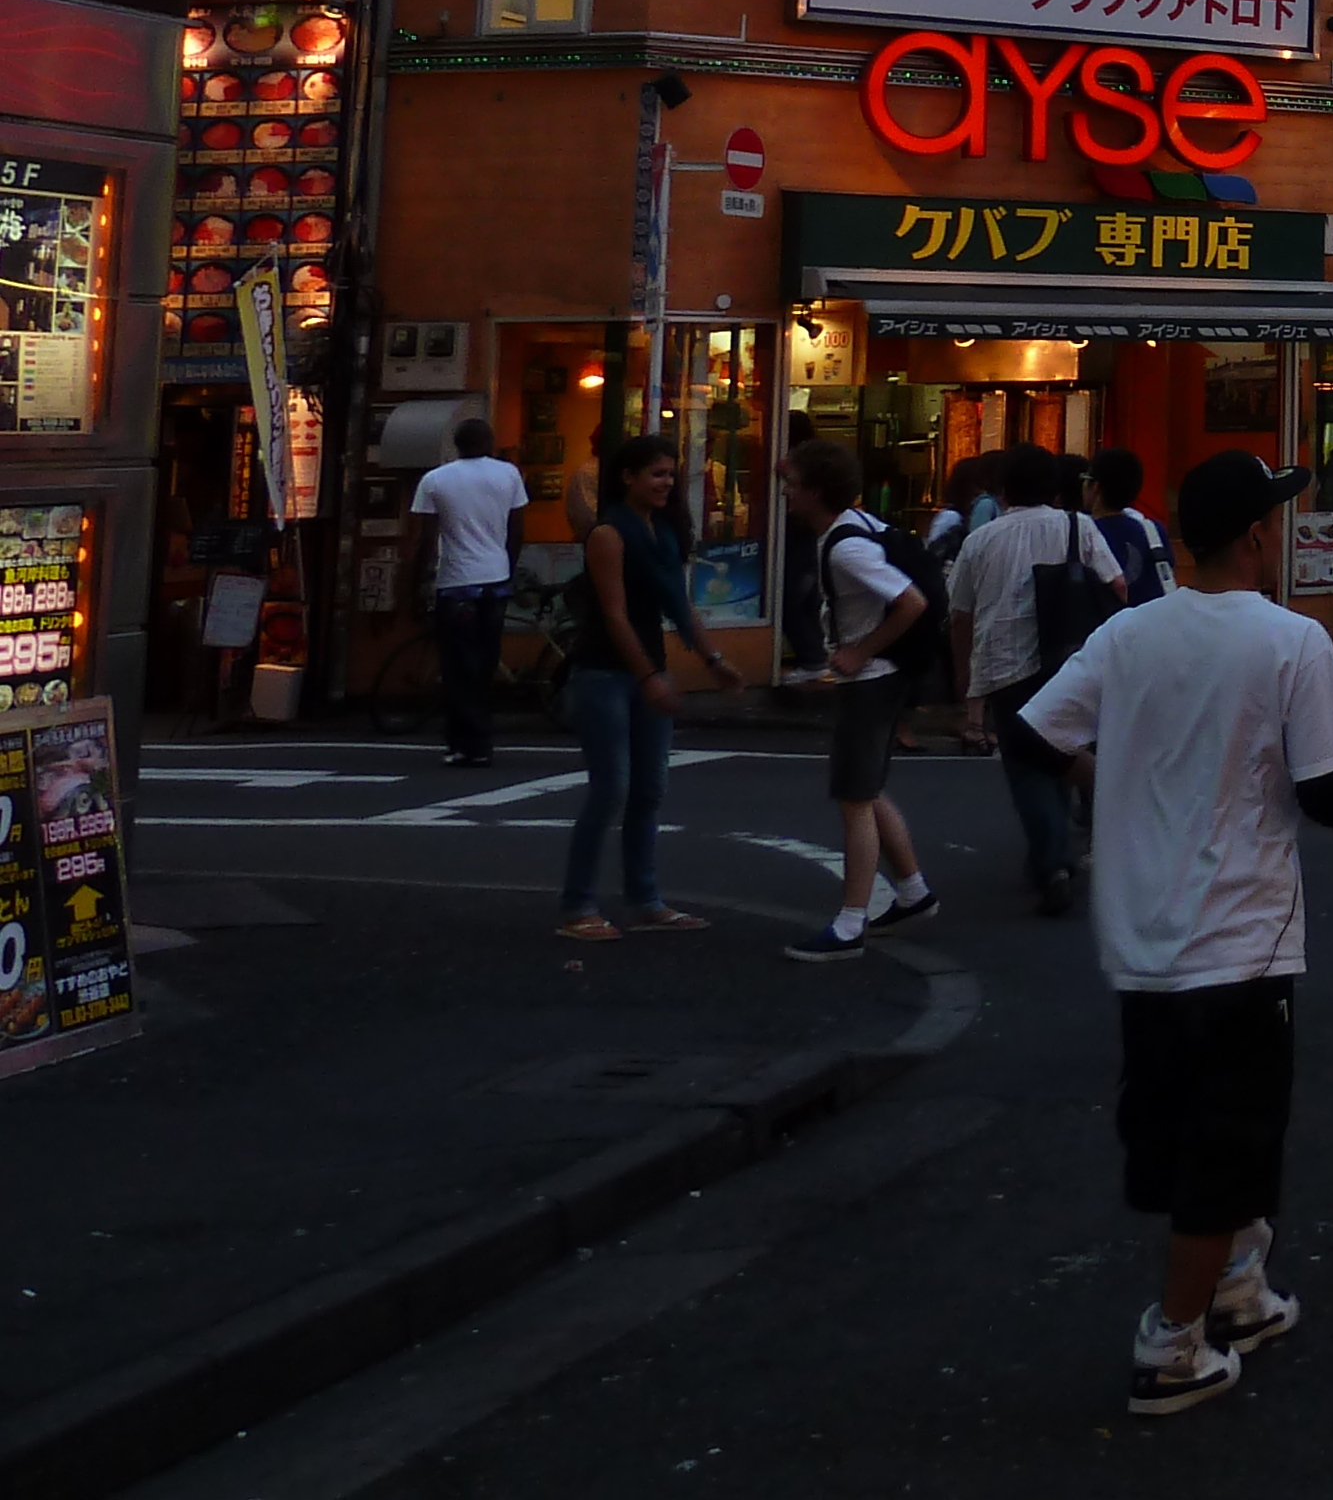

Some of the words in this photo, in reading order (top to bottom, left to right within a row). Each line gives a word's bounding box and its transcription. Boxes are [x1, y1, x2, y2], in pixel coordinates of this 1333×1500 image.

[894, 203, 1074, 263] ケバブ
[1094, 211, 1255, 272] 専門店
